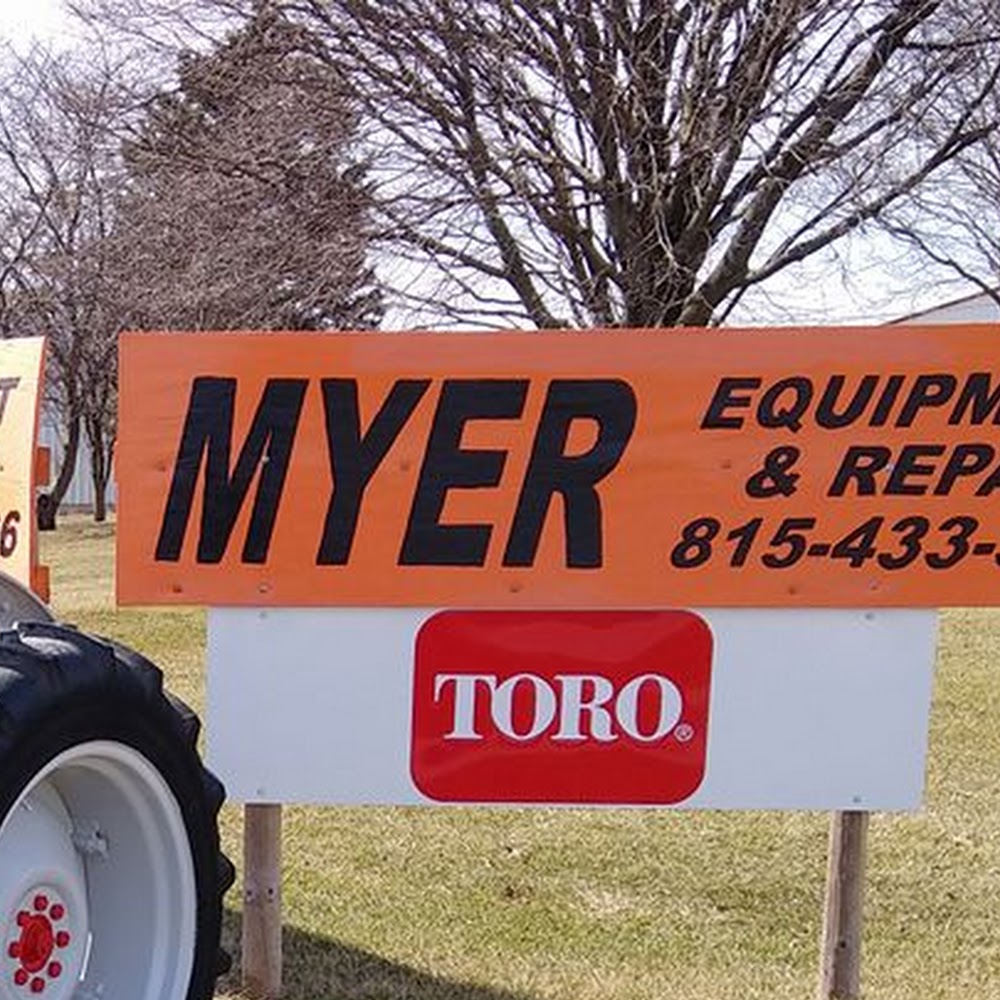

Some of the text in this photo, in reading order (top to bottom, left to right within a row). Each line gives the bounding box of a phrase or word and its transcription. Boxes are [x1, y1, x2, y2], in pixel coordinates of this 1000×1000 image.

[154, 375, 638, 569] MYER
[745, 445, 801, 499] &
[670, 515, 1000, 570] 815-433-
